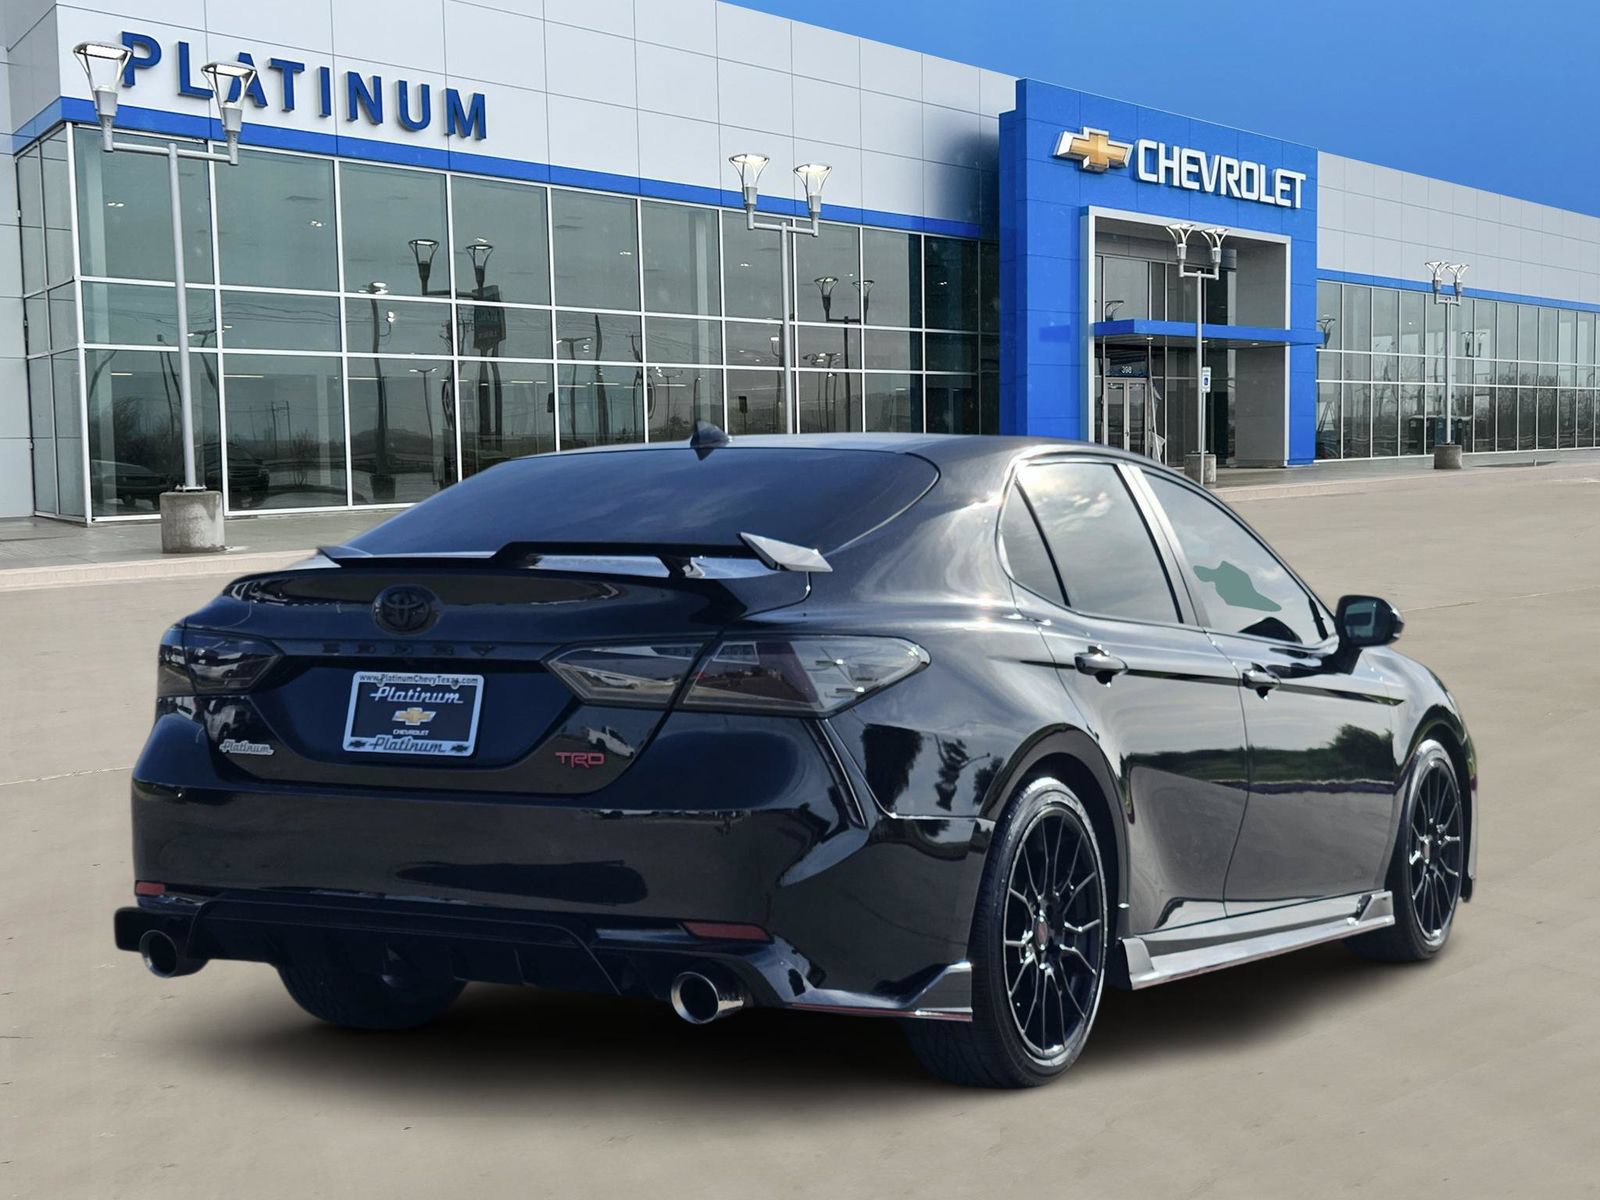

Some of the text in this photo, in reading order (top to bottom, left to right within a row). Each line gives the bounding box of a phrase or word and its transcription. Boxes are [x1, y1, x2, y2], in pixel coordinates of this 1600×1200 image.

[119, 31, 488, 141] PLATINUM
[1136, 138, 1307, 209] CHEVROLET
[370, 686, 464, 704] Platinum
[369, 736, 446, 753] Platinum
[555, 752, 605, 768] TRD
